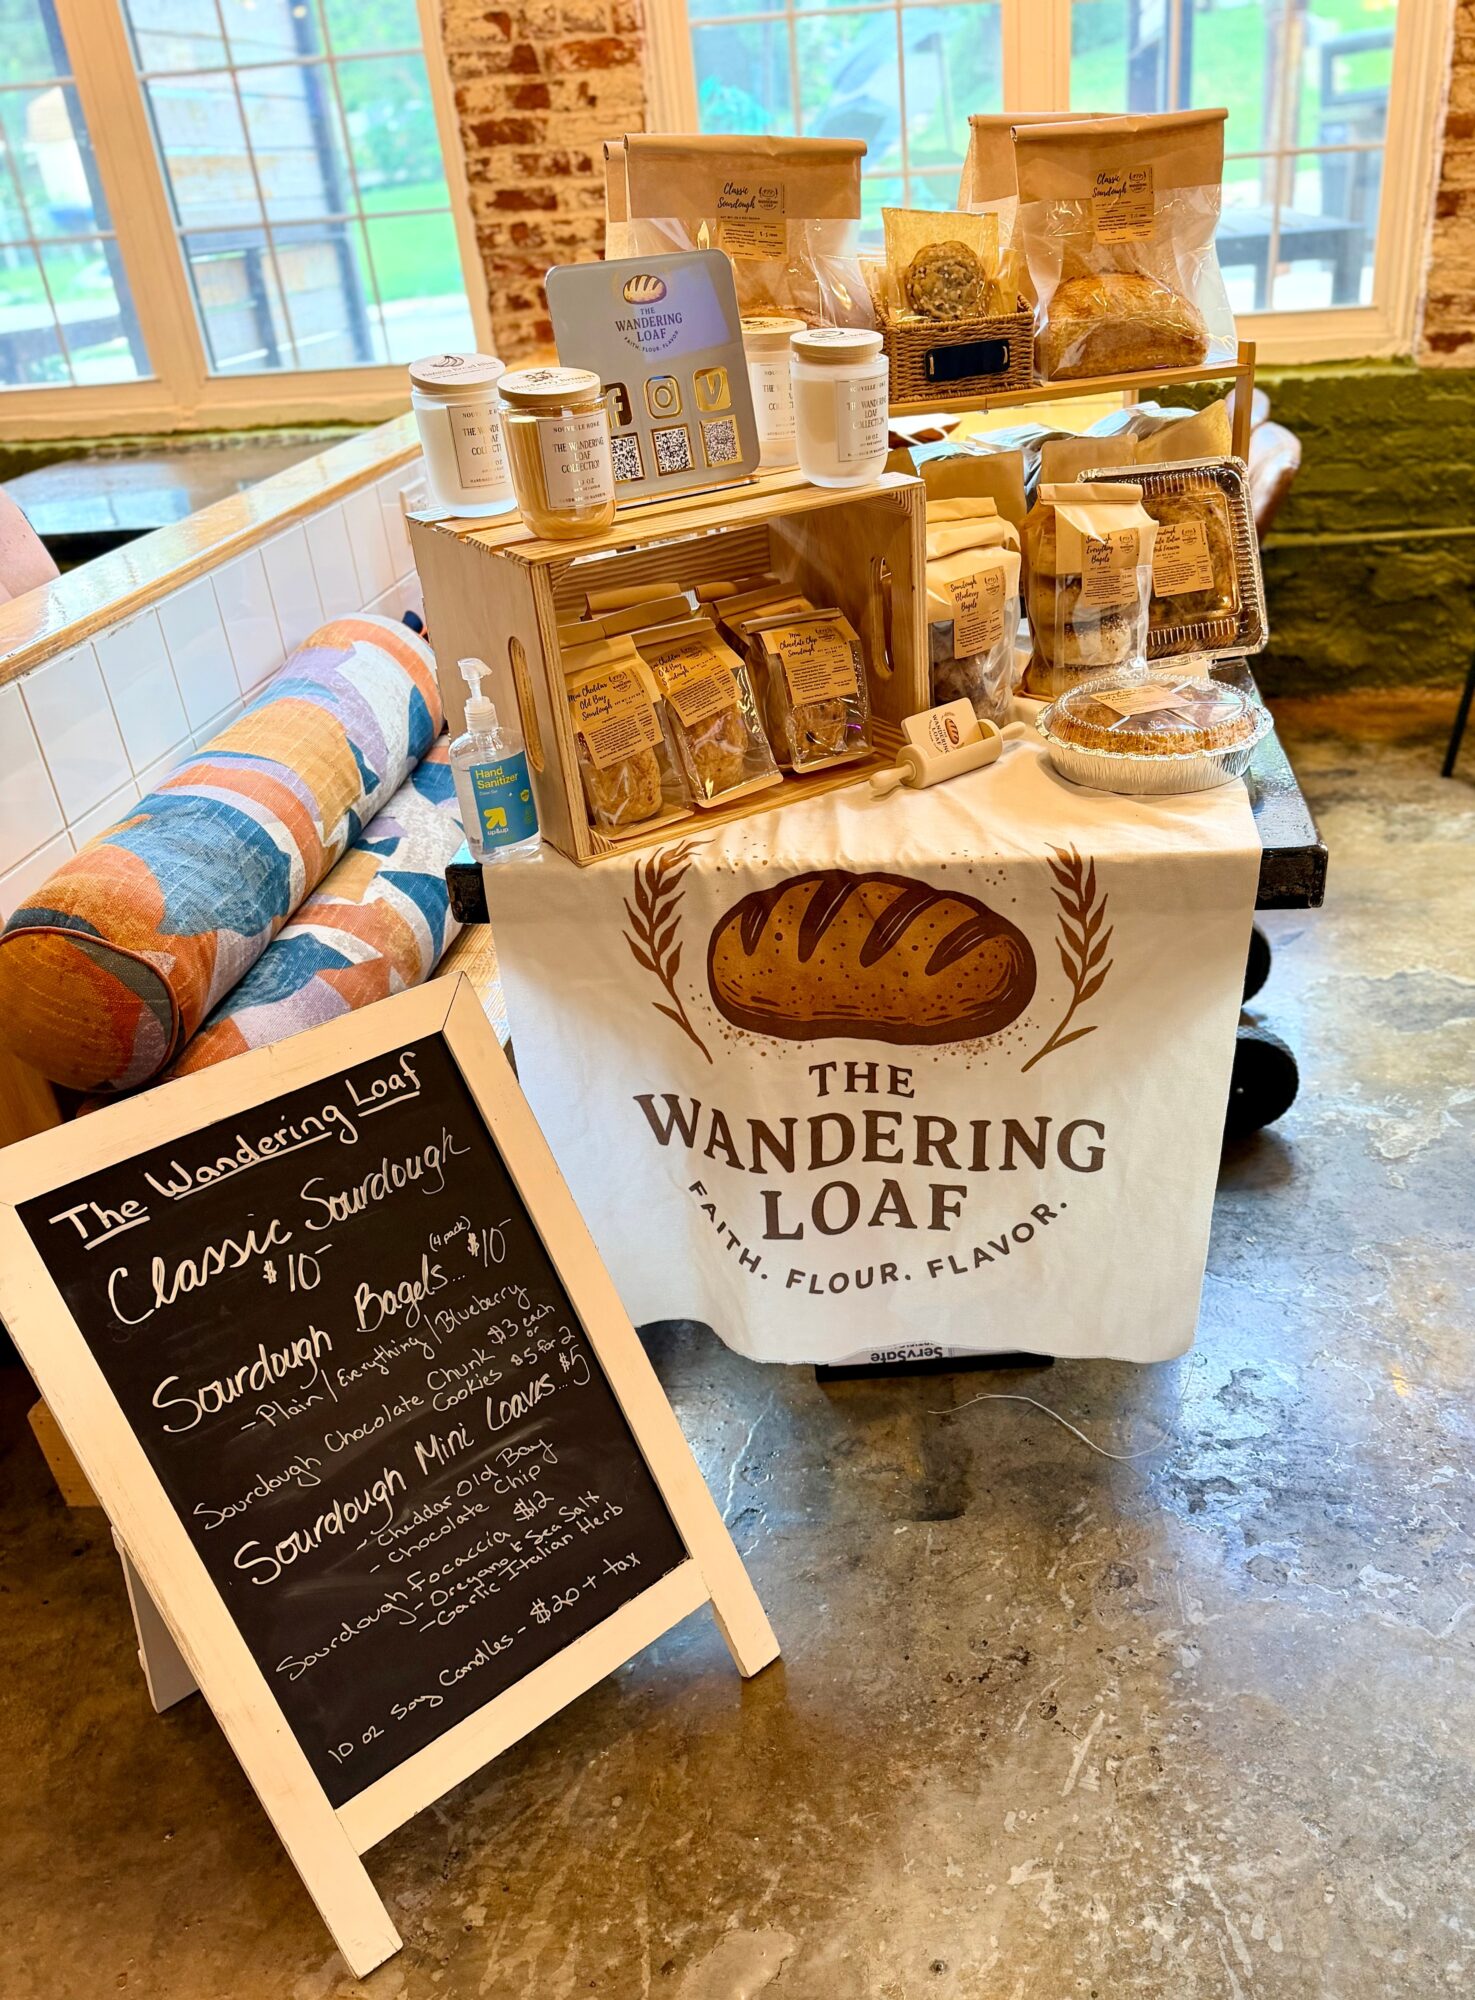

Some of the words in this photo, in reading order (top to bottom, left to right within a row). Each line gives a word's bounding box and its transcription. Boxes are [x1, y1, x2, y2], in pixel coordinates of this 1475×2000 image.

[1096, 172, 1120, 185] Classic
[723, 182, 749, 196] Classic
[1092, 181, 1127, 198] Sourdough
[717, 196, 756, 213] Sourdough
[639, 307, 656, 316] THE
[614, 312, 683, 333] WANDERING
[636, 328, 667, 343] LOAF
[553, 443, 567, 453] THE
[1086, 543, 1114, 556] Everything
[1090, 554, 1111, 566] Bagels
[950, 574, 978, 593] Sourdough
[954, 589, 979, 603] Blueberry
[960, 599, 978, 613] Bagels
[779, 639, 806, 651] Chocolate
[805, 635, 819, 646] Chip
[787, 644, 816, 658] Sourdough
[581, 682, 608, 698] Cheddar
[579, 698, 592, 711] Old
[592, 693, 608, 705] Bay
[581, 698, 613, 722] Sourdough
[474, 766, 504, 780] Hand
[476, 773, 519, 790] Sanitizer
[487, 827, 510, 837] up&up
[808, 1060, 915, 1099] THE
[633, 1093, 1106, 1175] WANDERING
[49, 1199, 150, 1250] The
[144, 1104, 359, 1199] Wandering
[345, 1051, 422, 1117] Loaf
[760, 1178, 968, 1241] LOAF
[107, 1213, 293, 1325] Classic
[300, 1126, 471, 1232] Sourdough
[688, 1180, 768, 1281] FAITH.
[785, 1262, 912, 1296] FLOUR.
[927, 1200, 1068, 1280] FLAVOR.
[526, 1326, 540, 1338] or
[870, 1347, 943, 1364] ServSafe
[432, 1369, 503, 1412] Cookies
[510, 1347, 538, 1366] $5
[536, 1338, 557, 1354] for
[558, 1325, 577, 1345] 2
[152, 1324, 333, 1433] Sourdough
[193, 1455, 323, 1531] Sourdough
[324, 1393, 425, 1453] Chocolate
[426, 1347, 496, 1391] Chunk
[486, 1318, 519, 1345] $3
[522, 1302, 556, 1328] each
[233, 1466, 408, 1586] Sourdough
[413, 1422, 475, 1476] Mini
[558, 1343, 592, 1387] $5
[377, 1494, 453, 1547] Cheddar
[456, 1463, 500, 1498] Old
[495, 1438, 559, 1469] Bay
[388, 1502, 490, 1564] Chocolate
[493, 1464, 542, 1495] Chip
[525, 1523, 563, 1546] Sea
[557, 1489, 601, 1524] Salt
[497, 1533, 574, 1582] Italian
[574, 1501, 625, 1536] Herb
[276, 1590, 417, 1682] Sourdough
[406, 1529, 513, 1593] Focaccia
[512, 1489, 556, 1522] $12
[327, 1741, 355, 1765] 10
[438, 1632, 515, 1688] Candles
[529, 1587, 581, 1625] $20
[601, 1551, 643, 1578] tax
